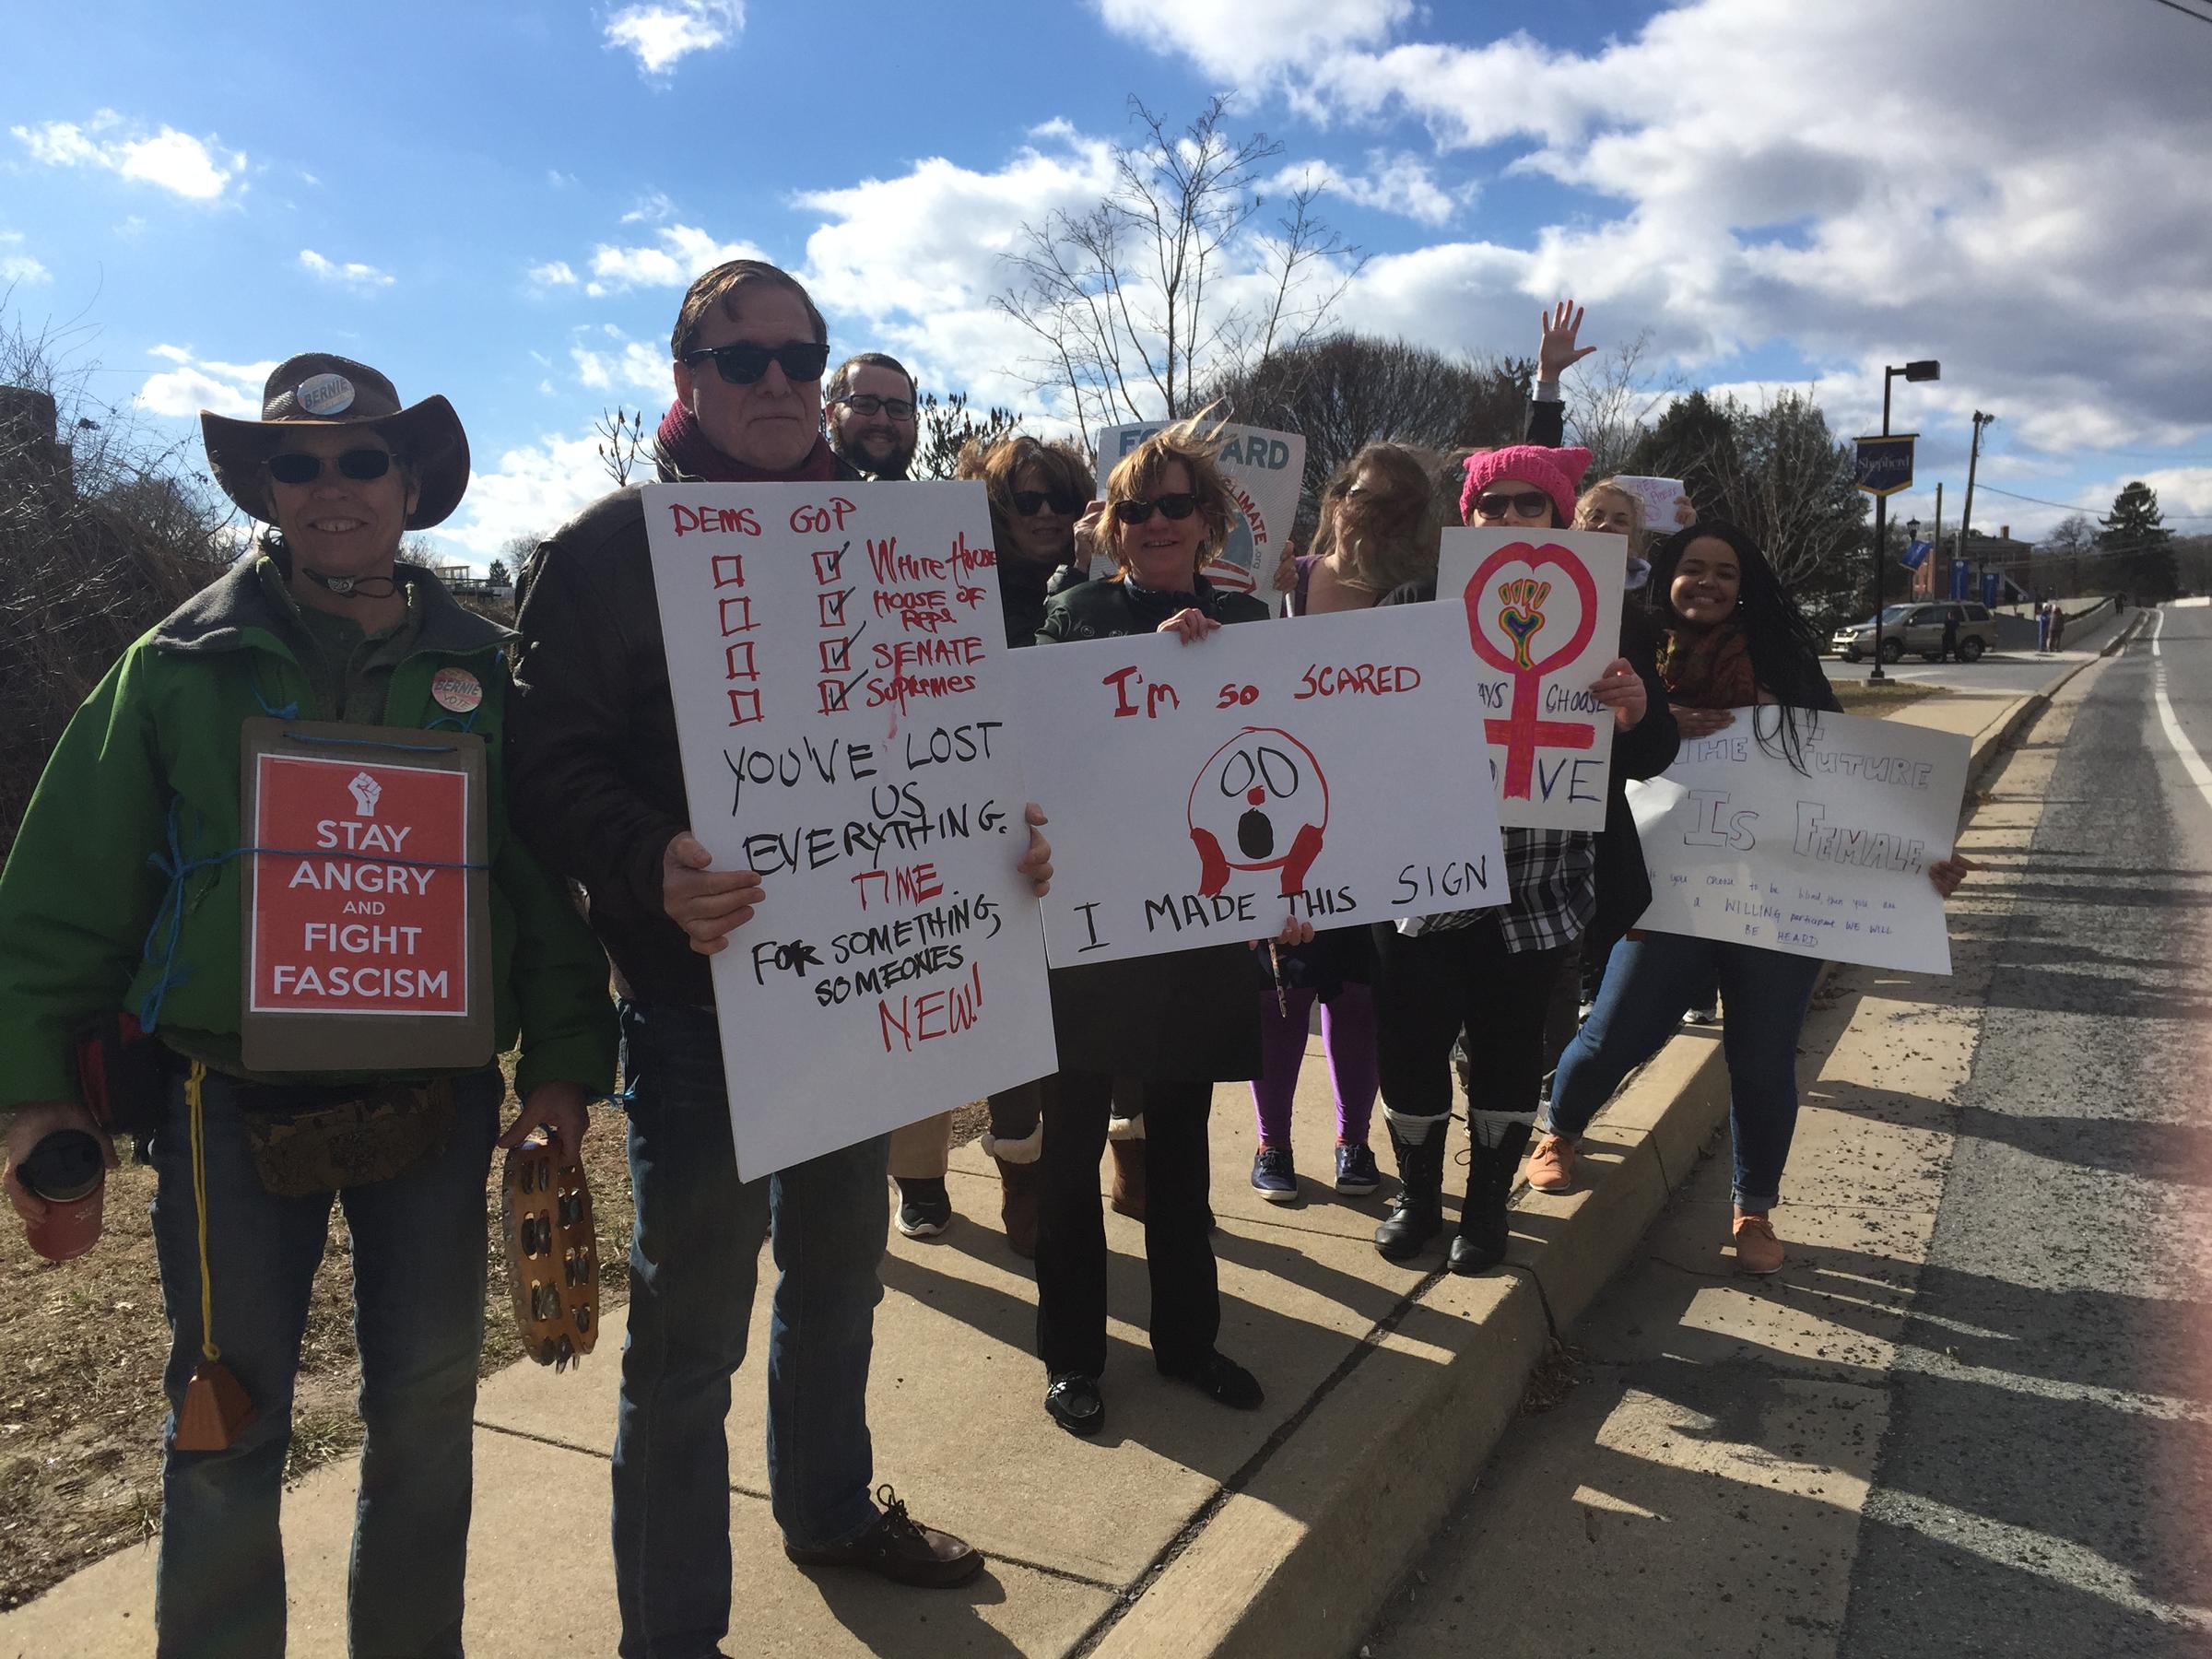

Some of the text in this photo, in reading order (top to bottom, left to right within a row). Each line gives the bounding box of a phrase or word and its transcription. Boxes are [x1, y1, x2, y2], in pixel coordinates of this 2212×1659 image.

[668, 497, 857, 537] DEMS GOP
[956, 585, 986, 610] OF
[872, 636, 986, 669] SENATE
[1293, 663, 1422, 700] SCARED
[724, 721, 1003, 818] YOU'VE LOST
[871, 781, 926, 820] US
[316, 819, 412, 853] STAY
[1794, 800, 1925, 875] FEMALE
[288, 860, 436, 896] ANGRY
[850, 862, 944, 912] TIME
[342, 900, 386, 916] AND
[1073, 853, 1488, 953] I MADE THIS SIGN
[1724, 898, 1783, 924] WILLING
[1845, 921, 1861, 932] WE
[1869, 924, 1894, 935] WILL
[304, 923, 423, 955] FIGHT
[1745, 924, 1759, 937] BE
[751, 939, 825, 985] FOR
[274, 965, 448, 999] FASCISM
[877, 961, 983, 1053] NEW!
